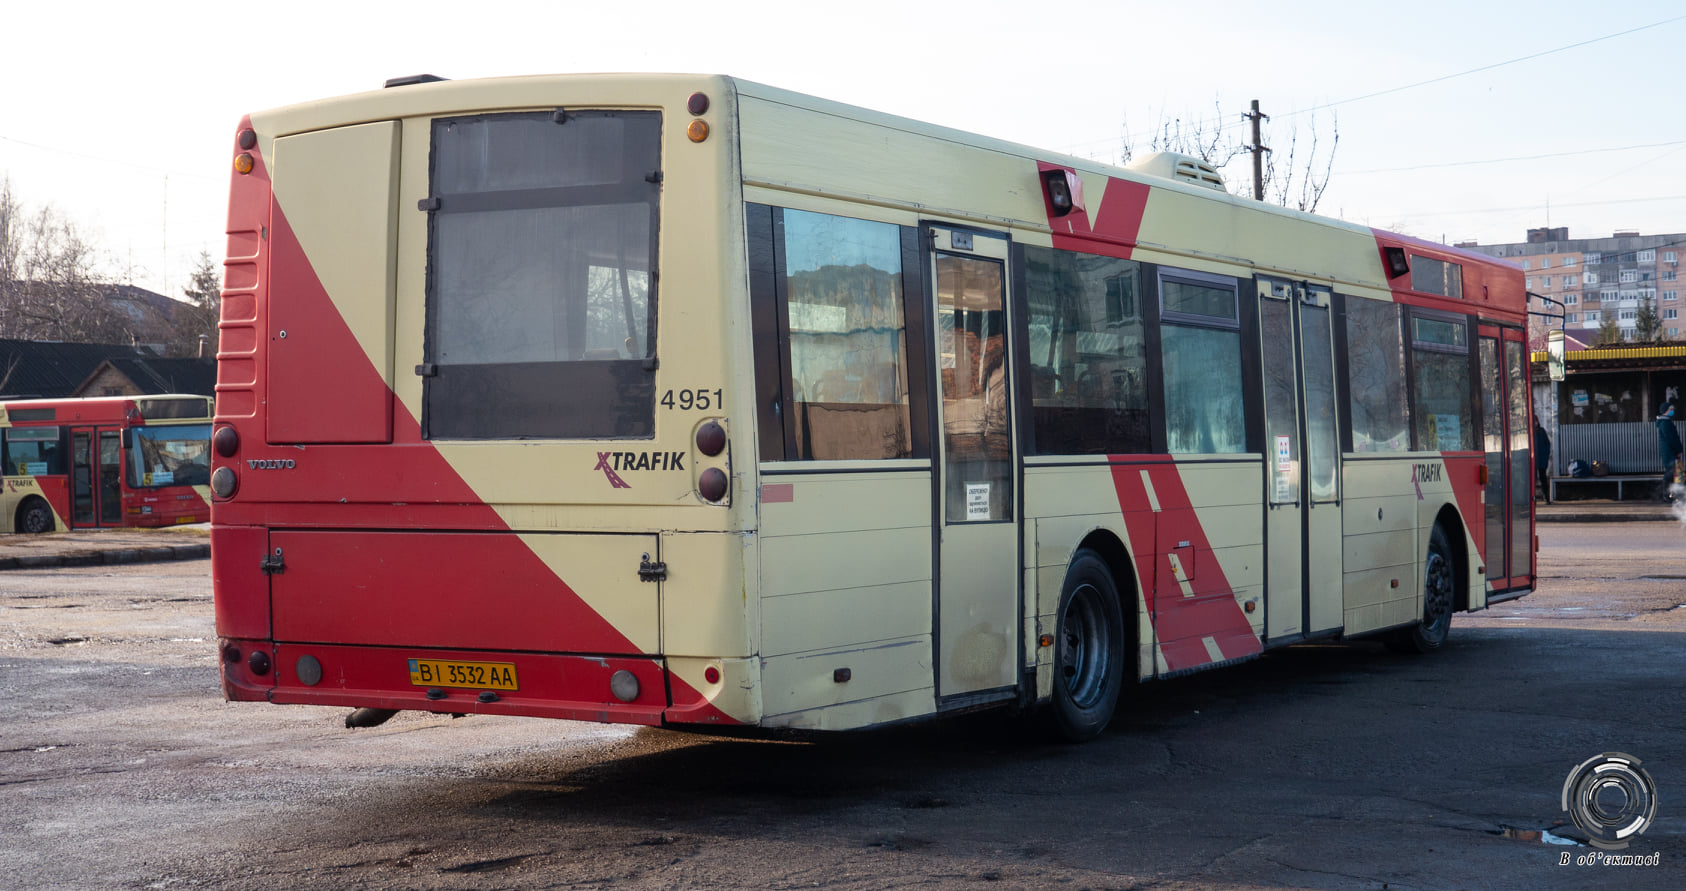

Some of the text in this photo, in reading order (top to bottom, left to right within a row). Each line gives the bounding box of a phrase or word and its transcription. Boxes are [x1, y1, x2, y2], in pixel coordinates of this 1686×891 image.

[660, 388, 723, 411] 4951
[246, 459, 296, 470] VOLVO
[594, 451, 686, 489] XTRAFIK
[1411, 463, 1442, 500] XTRAFIK
[419, 664, 514, 686] BI 3532 AA
